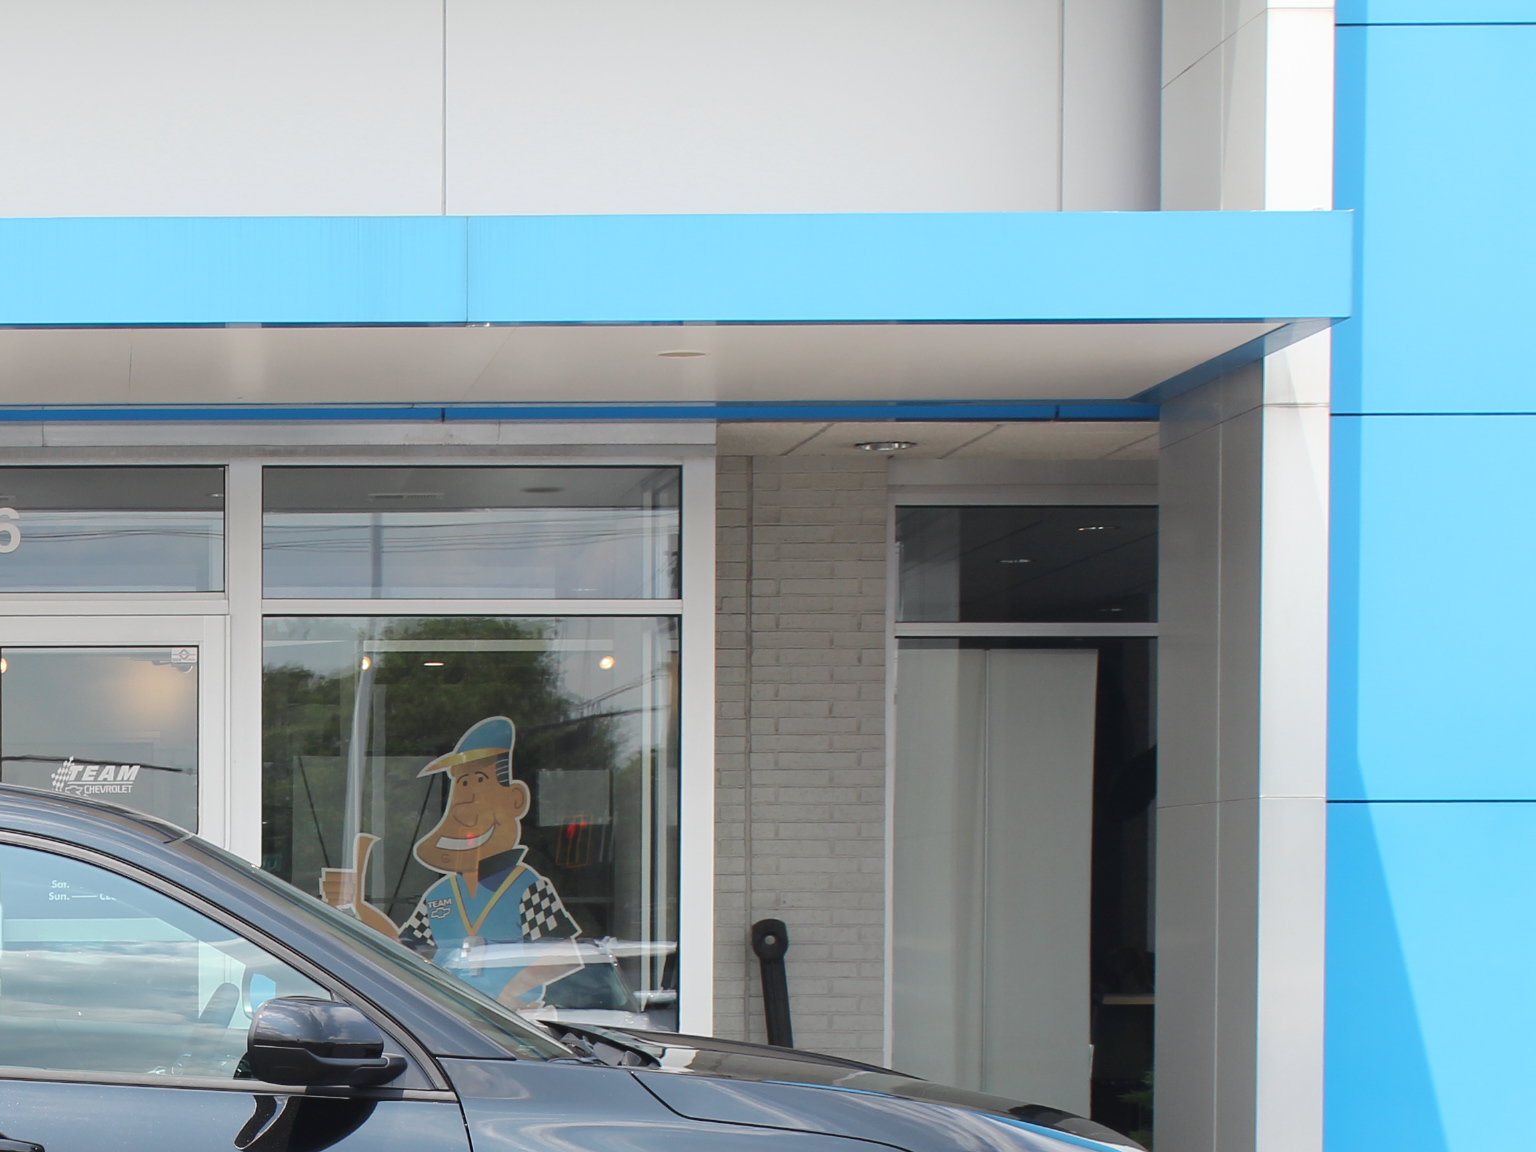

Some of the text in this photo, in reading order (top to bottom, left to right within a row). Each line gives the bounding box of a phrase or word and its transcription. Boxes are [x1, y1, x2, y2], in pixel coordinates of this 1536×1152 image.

[67, 765, 141, 781] TEAM
[84, 785, 133, 794] CHEVROLET
[48, 892, 70, 901] Sun.
[427, 898, 452, 909] TEAM
